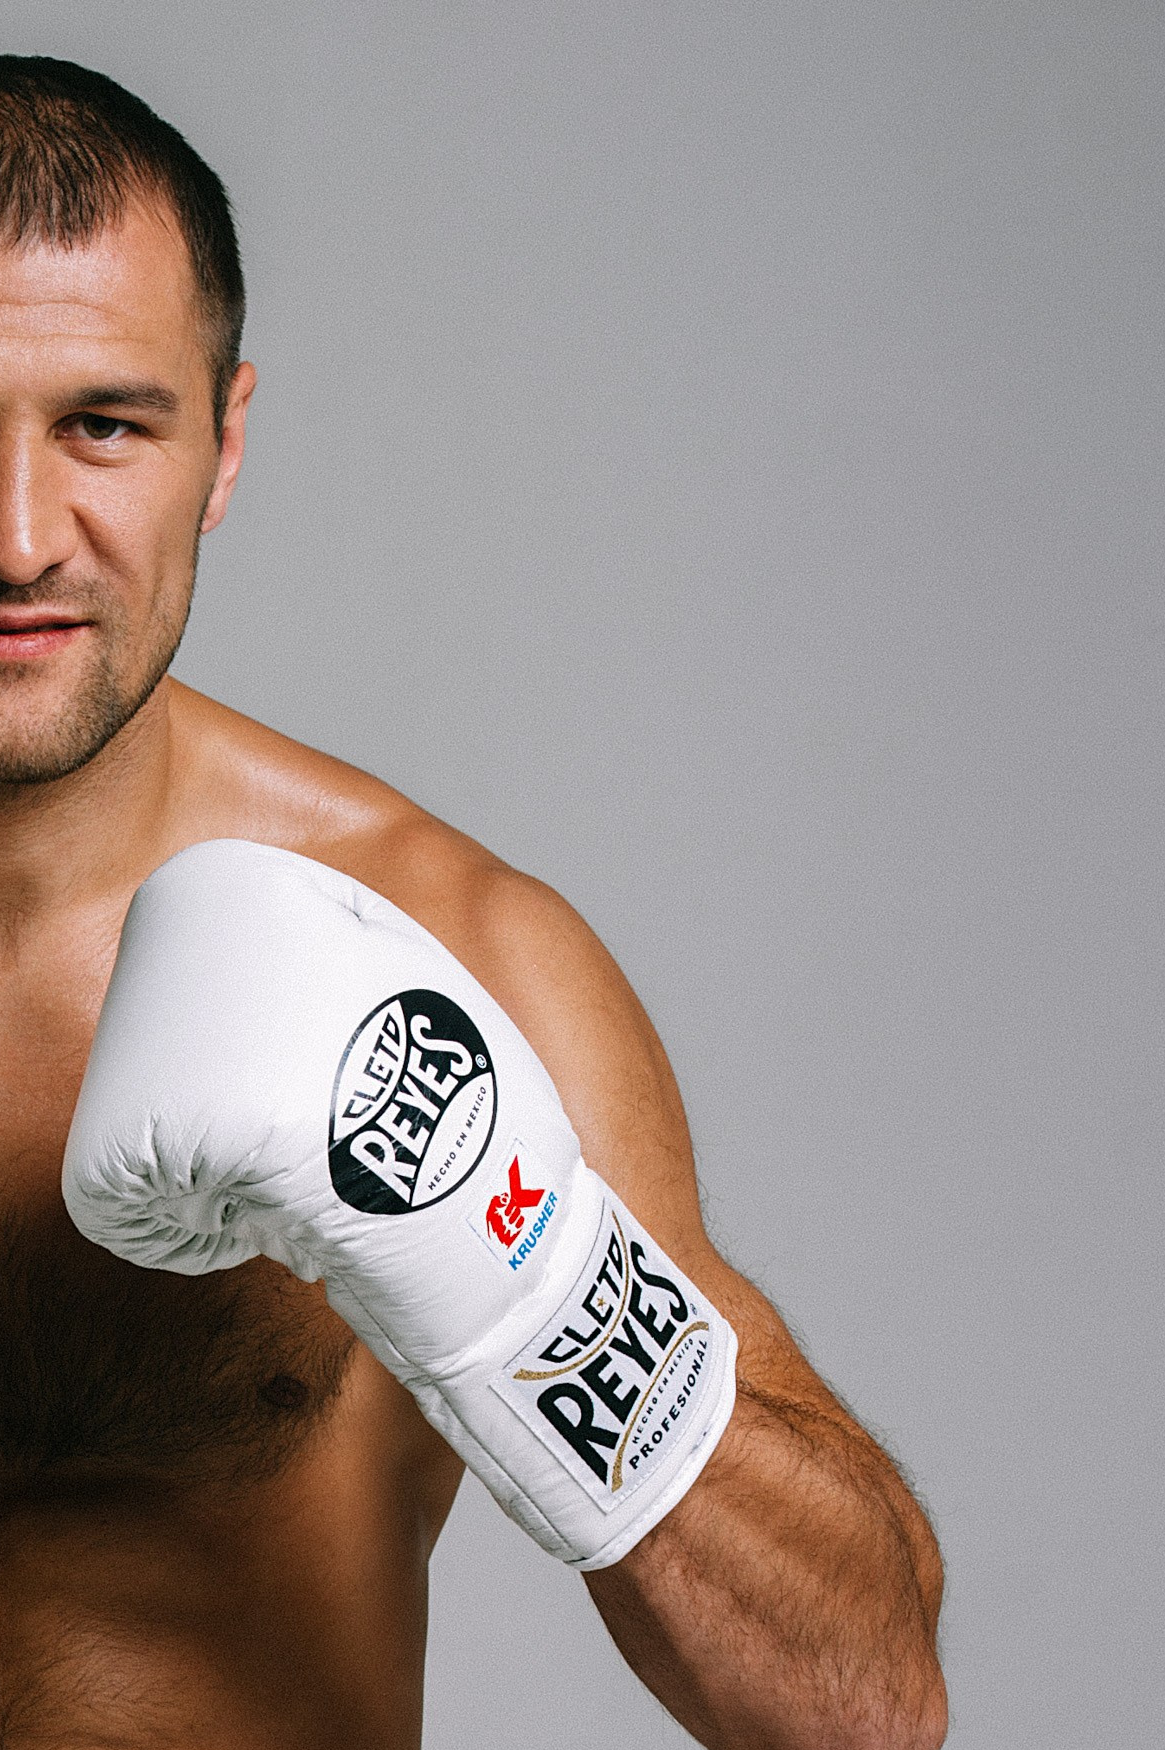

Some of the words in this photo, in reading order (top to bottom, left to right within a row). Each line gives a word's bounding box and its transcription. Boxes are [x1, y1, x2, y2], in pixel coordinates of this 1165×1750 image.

[349, 1014, 473, 1204] REYES
[427, 1152, 457, 1191] HECHO
[455, 1131, 468, 1149] EN
[466, 1086, 487, 1130] MEXICO
[508, 1191, 558, 1271] KRUSHER
[536, 1240, 689, 1486] REYES
[628, 1339, 708, 1470] PROFESIONAL
[633, 1397, 658, 1444] HECHO
[658, 1378, 668, 1394] EN
[668, 1339, 693, 1375] MEXICO
